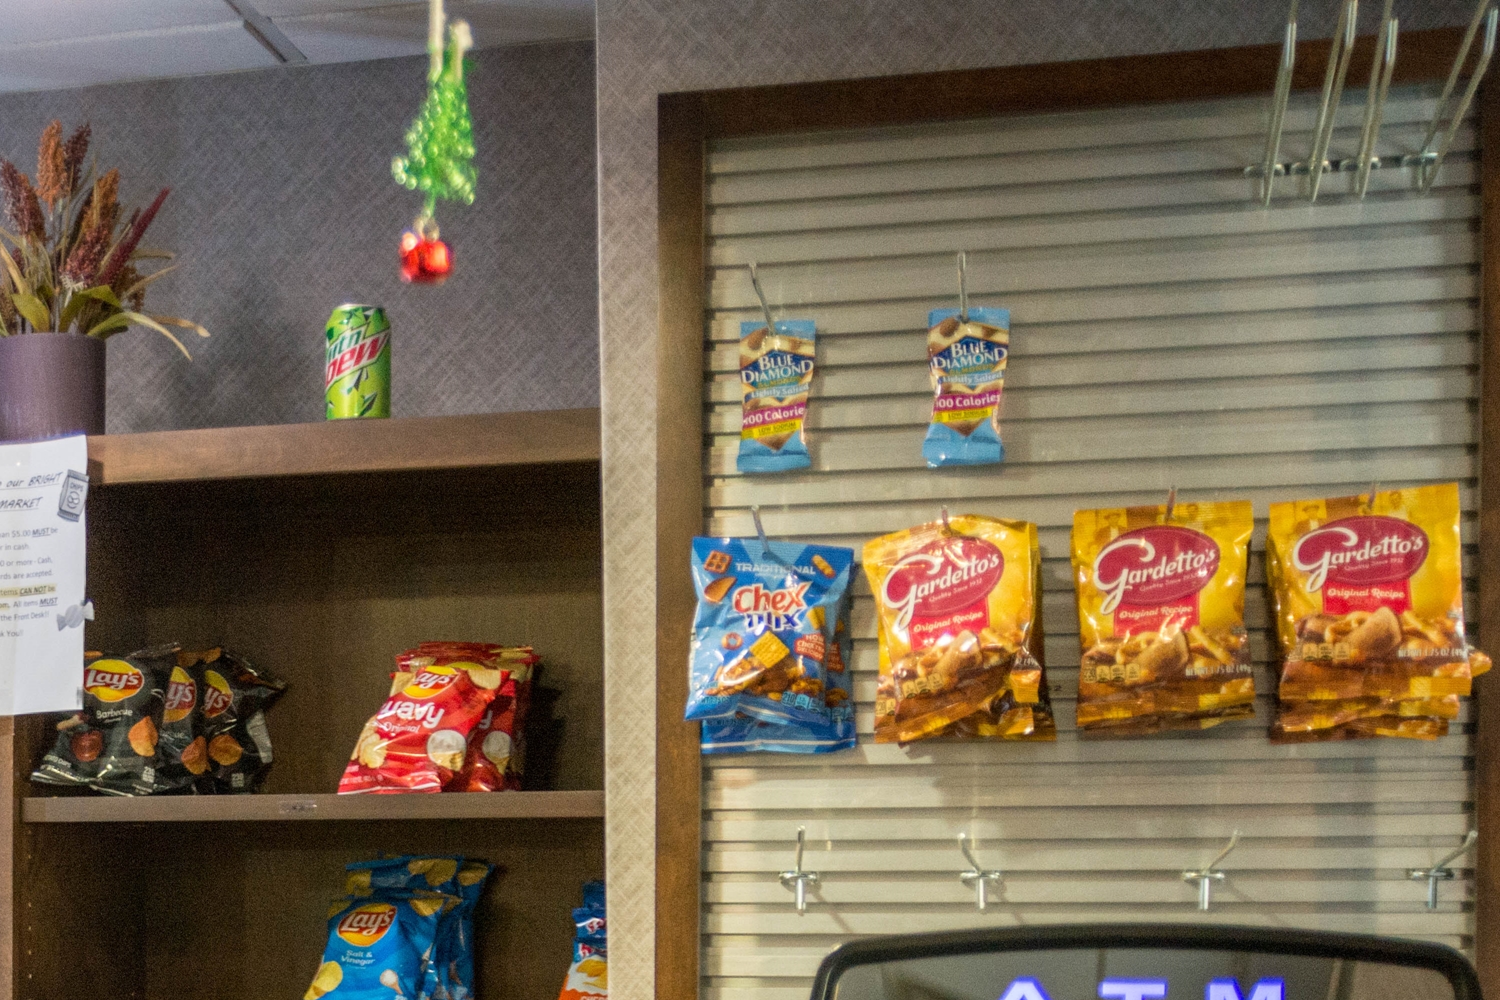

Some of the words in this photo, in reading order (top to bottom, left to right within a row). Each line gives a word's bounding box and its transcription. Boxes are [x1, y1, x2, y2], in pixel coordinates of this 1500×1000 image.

[742, 360, 814, 383] DIAMOND
[759, 354, 795, 370] BLUE
[28, 472, 63, 486] BRIGHT
[11, 530, 31, 538] $5.00
[32, 527, 50, 535] MUST
[736, 563, 816, 574] TRADITIONAL
[1293, 527, 1423, 593] Gardetto's
[1093, 538, 1216, 616] Gardetto's
[40, 597, 58, 605] MUST
[733, 581, 813, 614] Chex
[882, 553, 999, 631] Gardetto's
[86, 670, 140, 690] Lay's
[341, 908, 394, 935] Lay's
